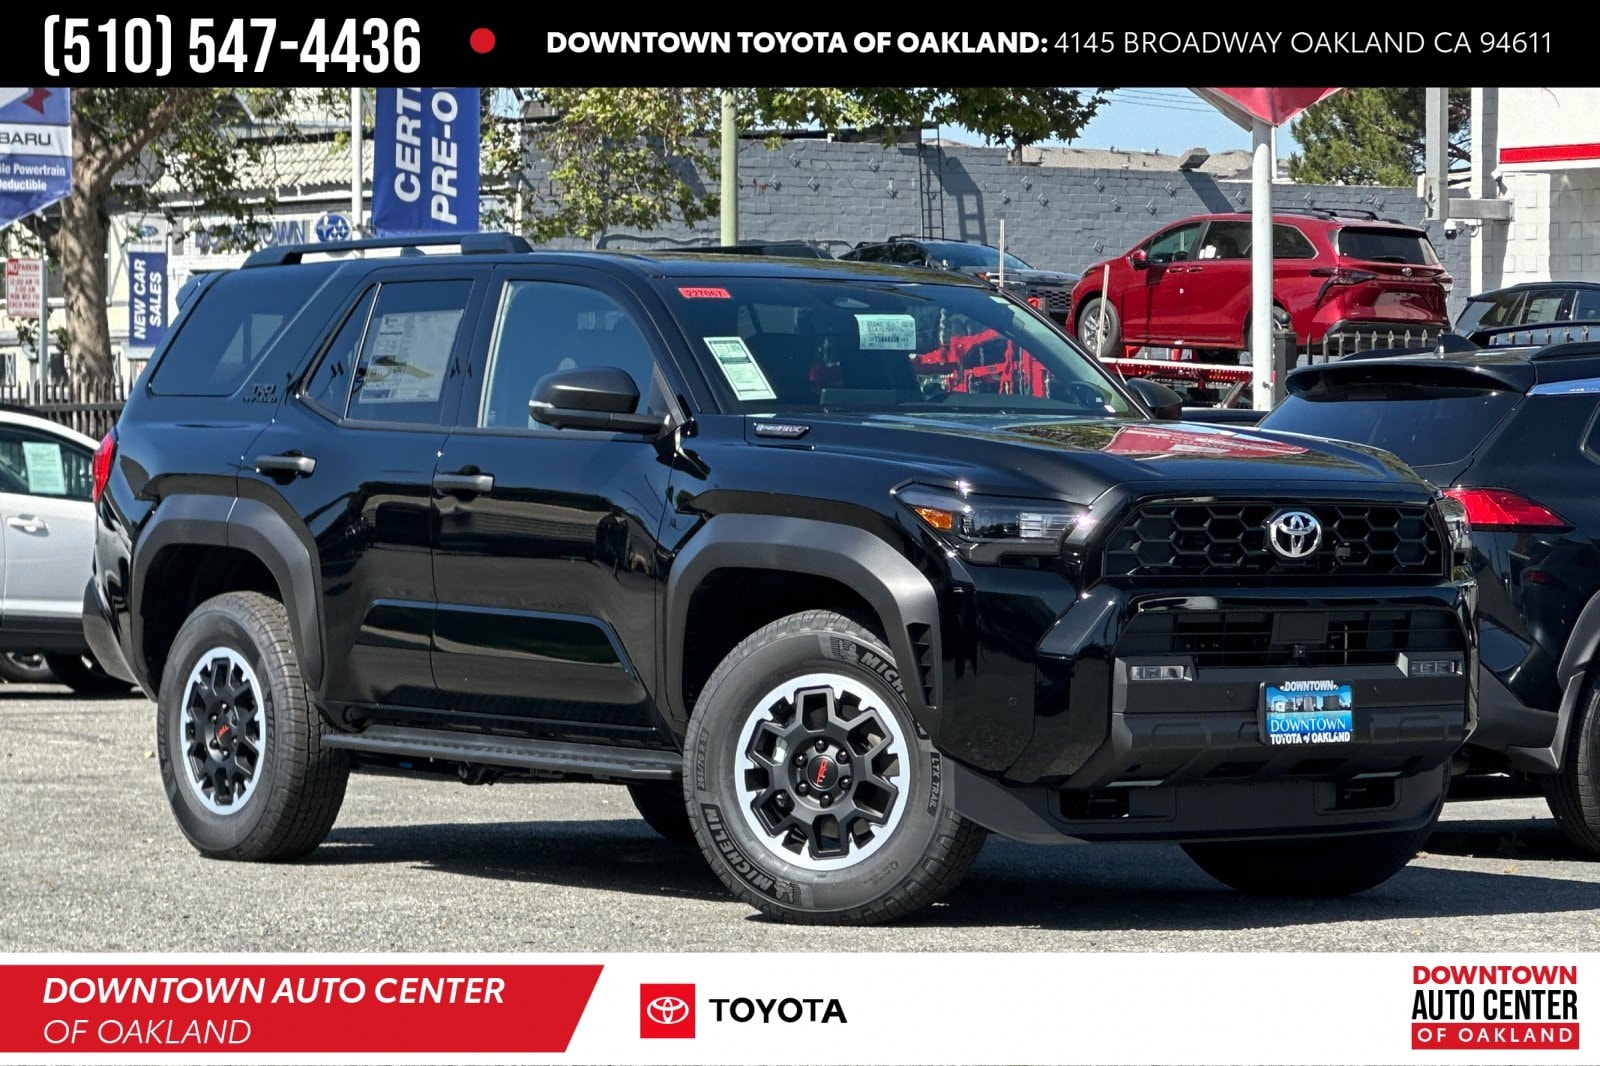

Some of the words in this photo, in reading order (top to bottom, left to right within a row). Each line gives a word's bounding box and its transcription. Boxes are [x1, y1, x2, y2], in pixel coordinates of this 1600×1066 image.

[0, 132, 51, 146] BARU
[431, 87, 458, 225] PRE-O
[13, 163, 66, 176] Powertrain
[133, 258, 147, 296] CAR
[149, 271, 162, 328] SALES
[133, 297, 147, 340] NEW
[1283, 680, 1335, 691] DOWNTOWN
[1270, 718, 1346, 733] DOWNTOWN
[1270, 732, 1303, 745] TOYOTA
[1311, 732, 1351, 743] OAKLAND
[931, 757, 940, 778] LTX
[929, 781, 940, 808] TRAIL
[704, 808, 774, 891] MICHELIN
